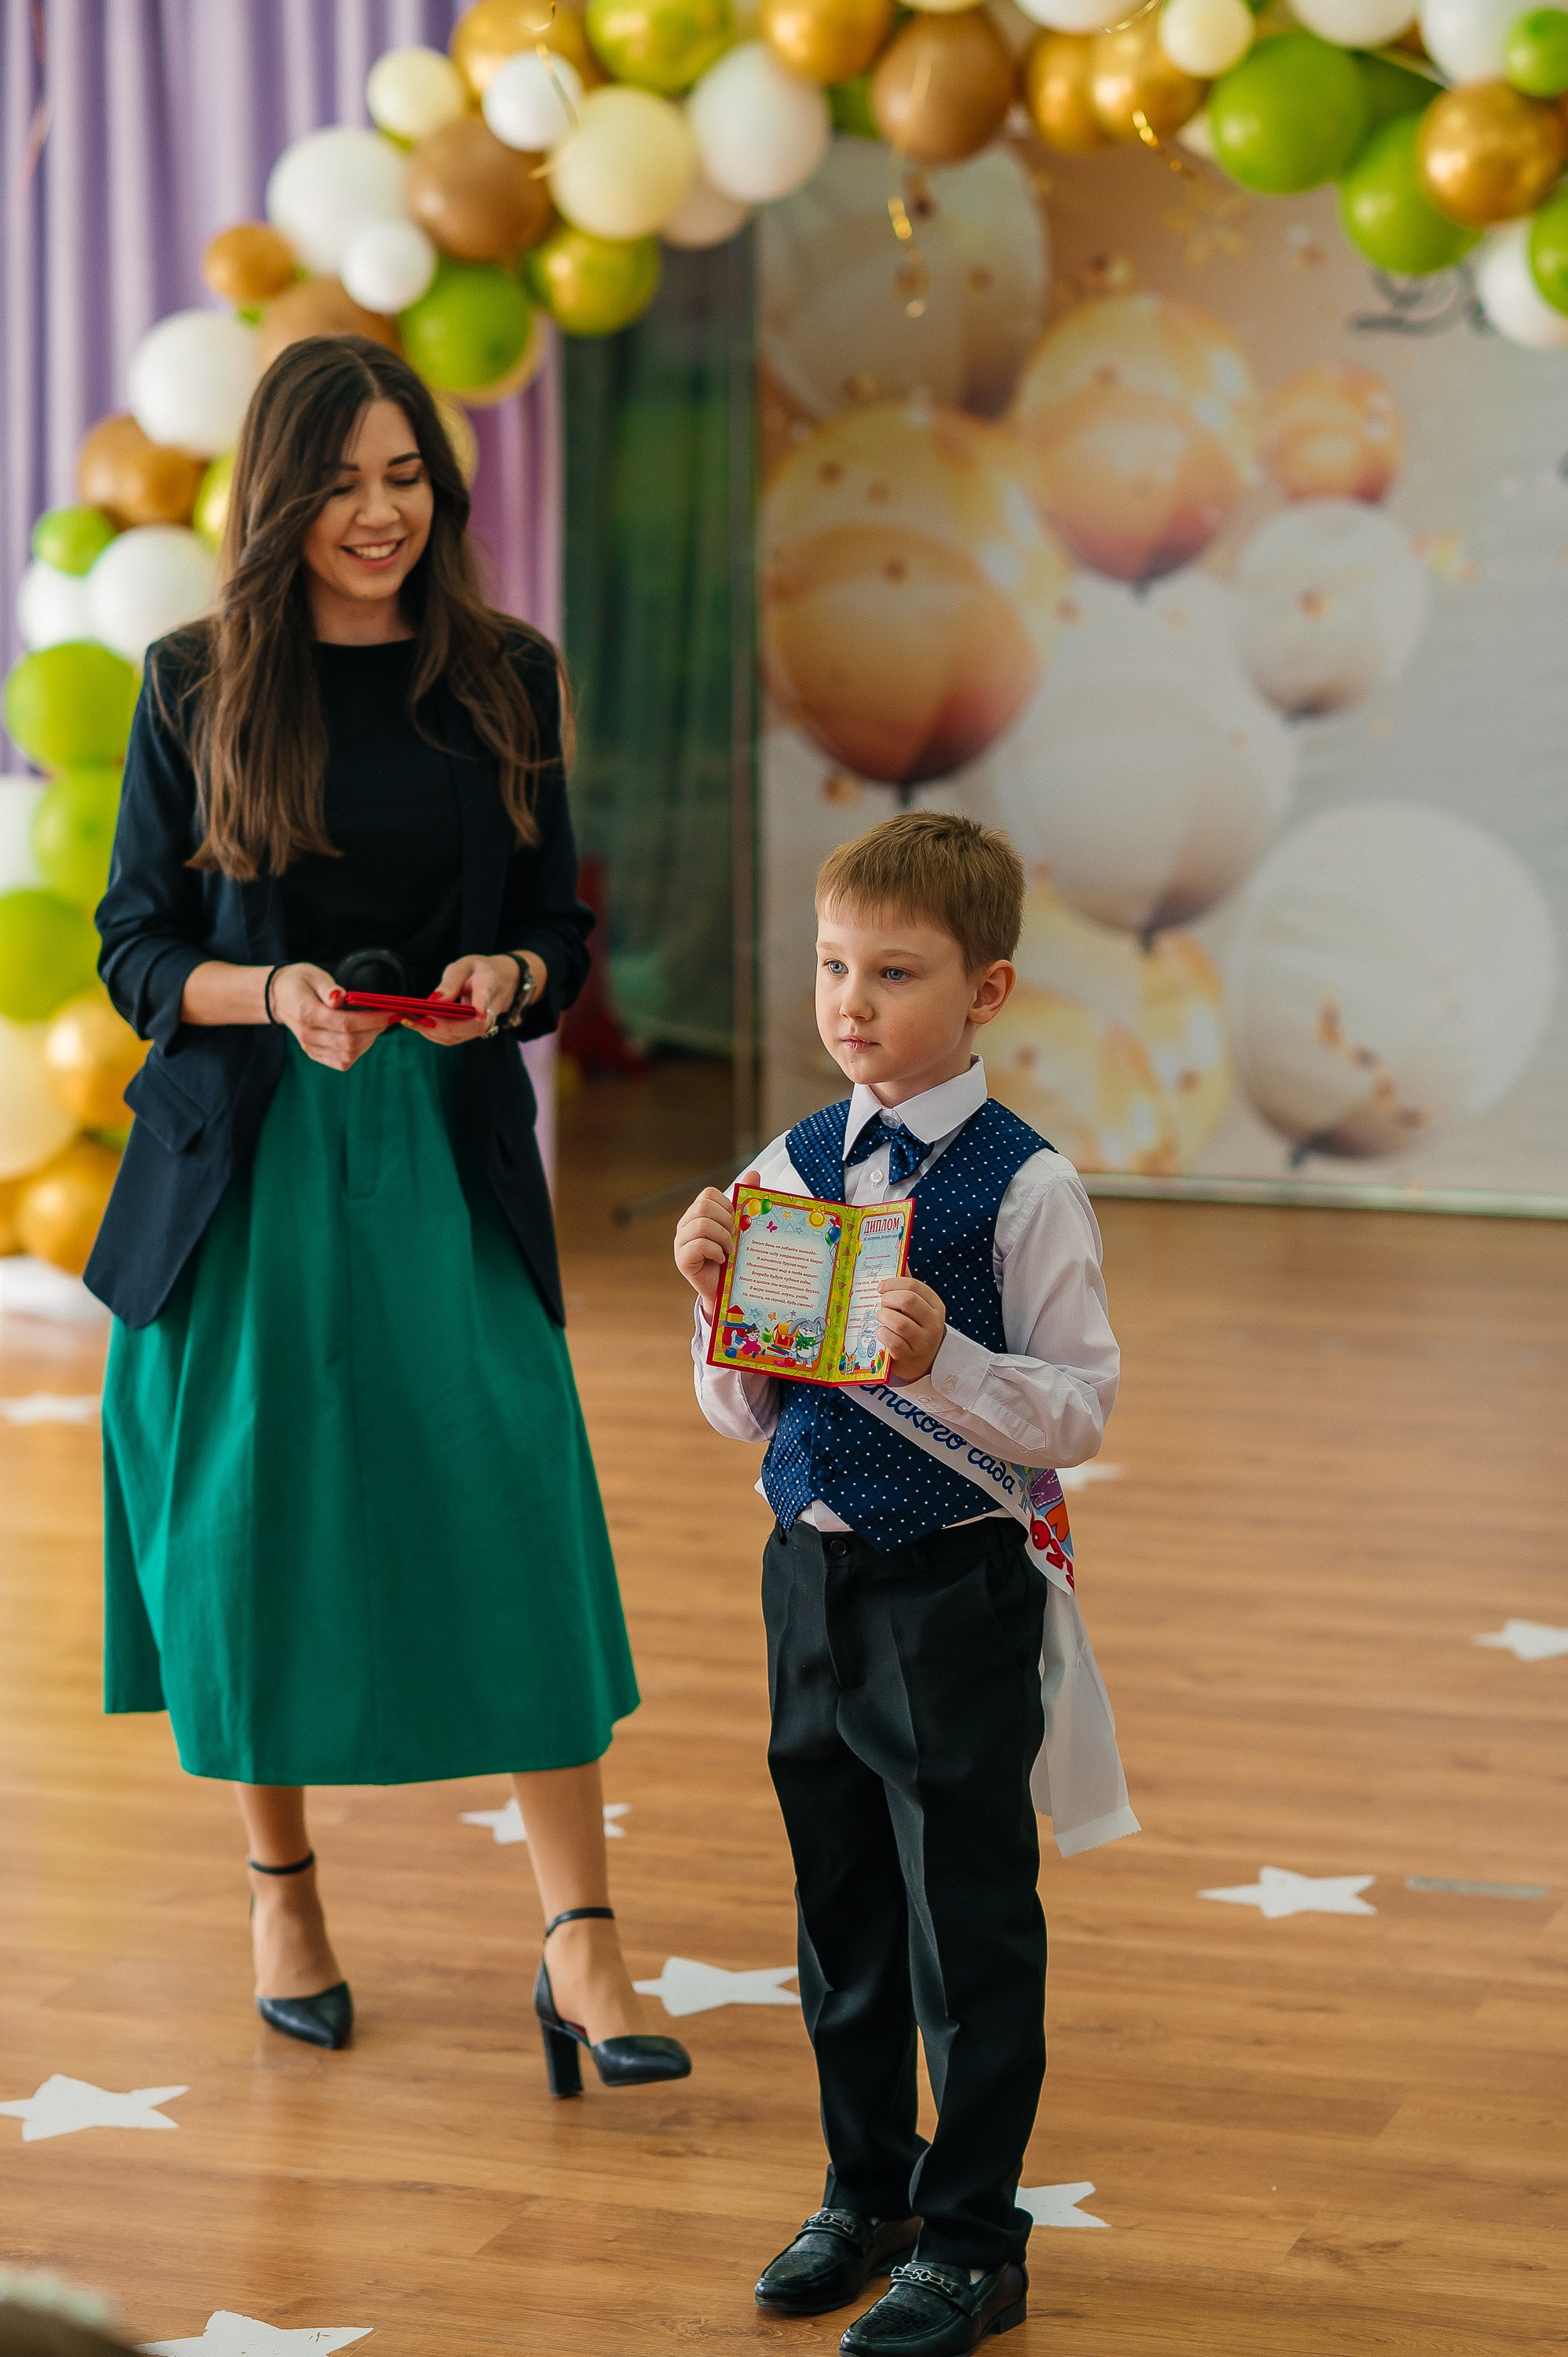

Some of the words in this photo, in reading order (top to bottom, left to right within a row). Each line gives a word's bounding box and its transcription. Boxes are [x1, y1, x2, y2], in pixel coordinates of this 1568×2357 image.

[864, 1218, 899, 1234] ДИПЛОМ
[779, 1253, 809, 1262] закрываются
[746, 1262, 779, 1271] Удивительный
[967, 1447, 1016, 1495] сада
